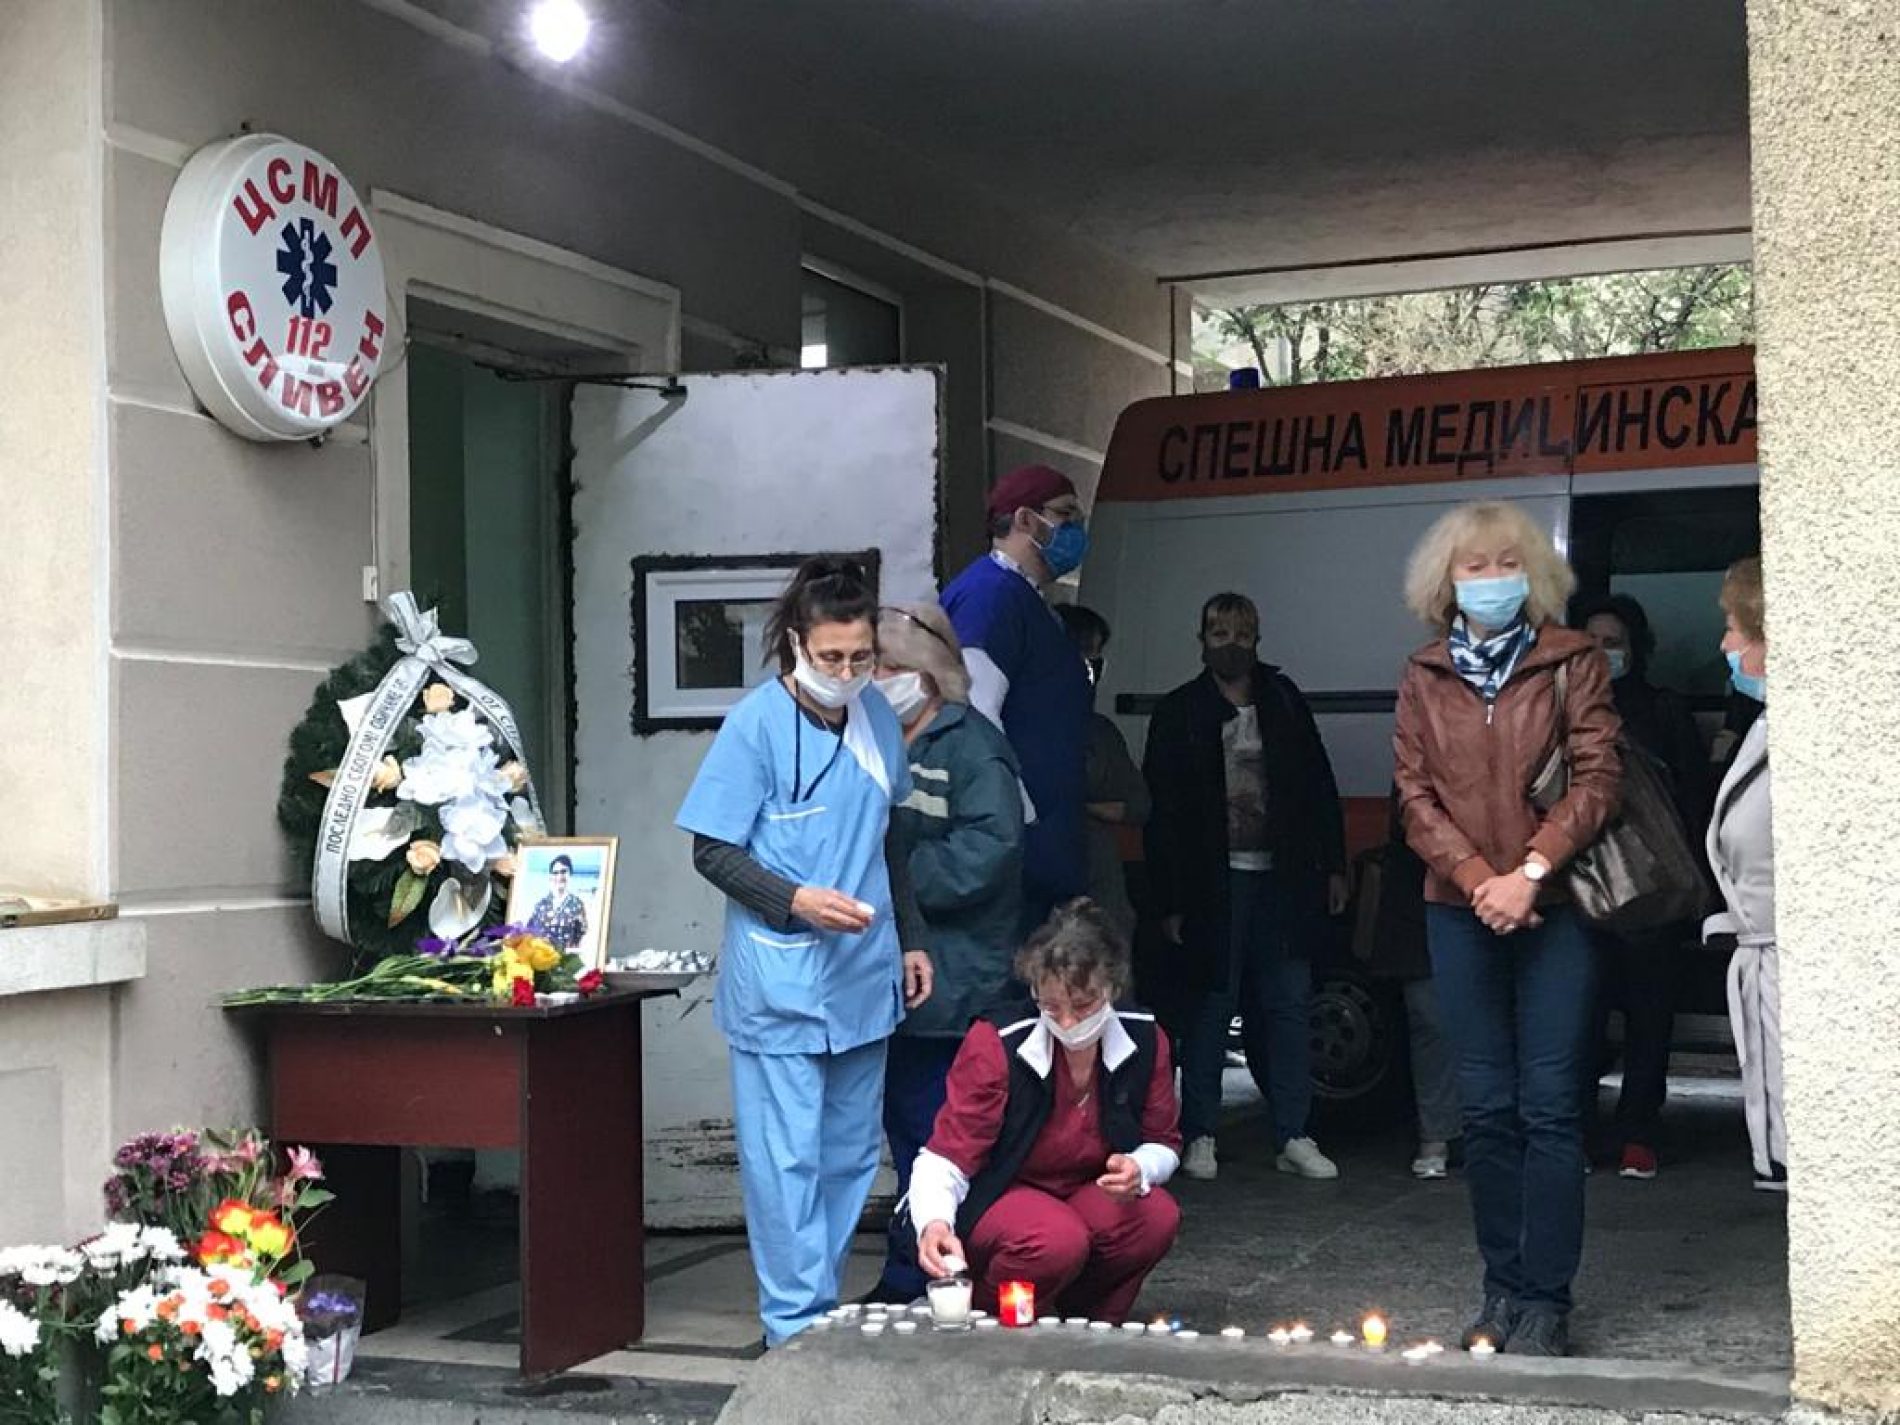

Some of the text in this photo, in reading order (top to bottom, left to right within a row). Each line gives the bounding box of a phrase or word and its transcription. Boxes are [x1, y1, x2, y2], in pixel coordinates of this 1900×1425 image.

[233, 157, 372, 260] ЦСМП
[227, 290, 385, 416] СЛИВЕН
[286, 314, 332, 361] 112
[1158, 411, 1368, 484] СПЕШНА
[326, 784, 357, 854] ПОСЛЕДНО
